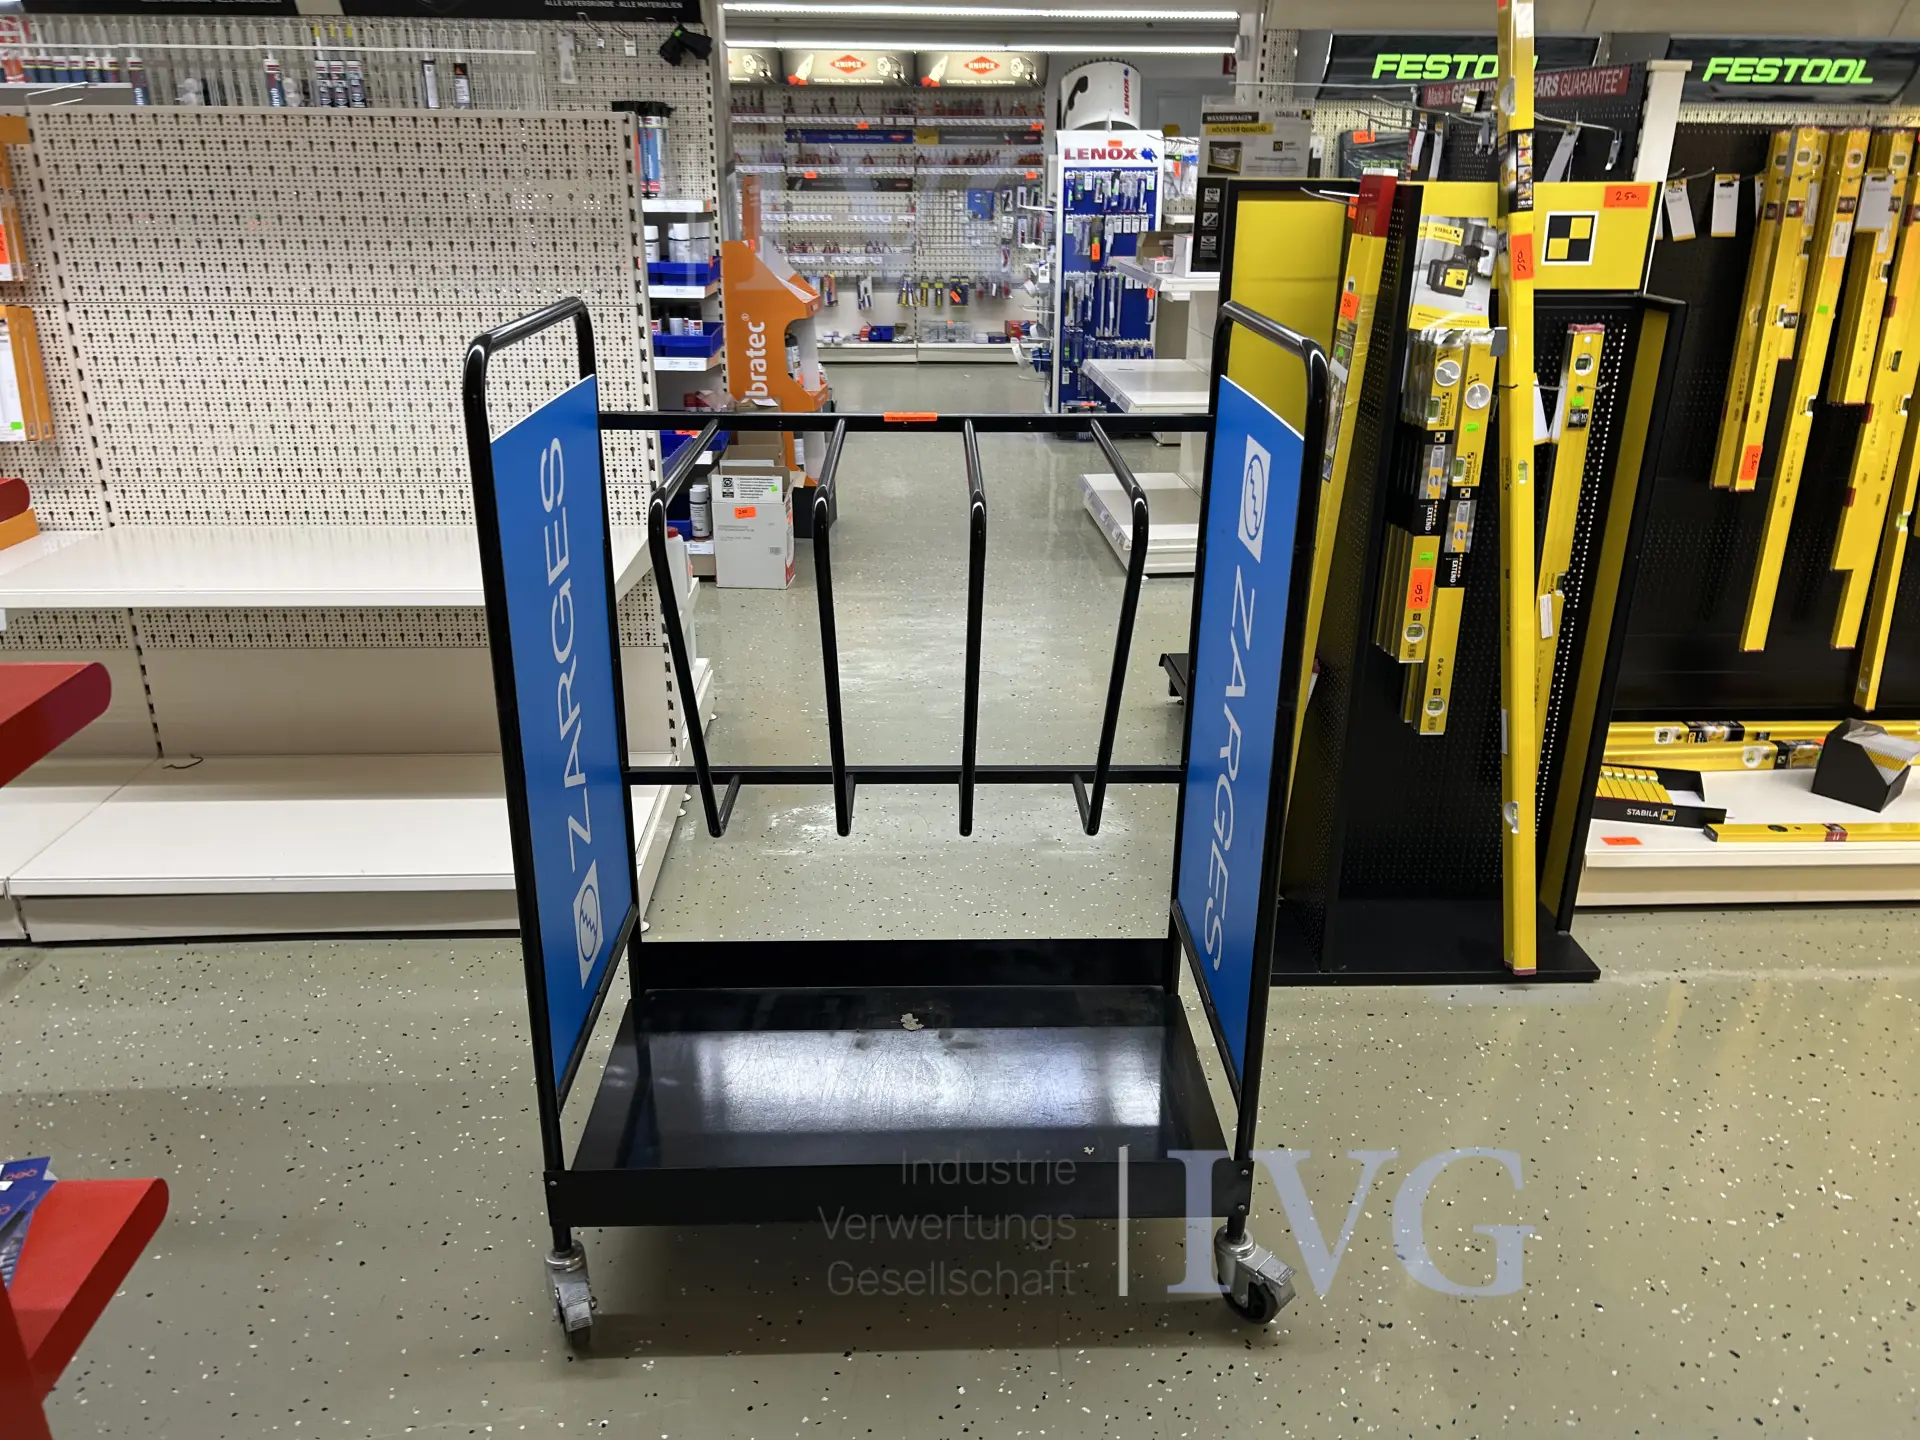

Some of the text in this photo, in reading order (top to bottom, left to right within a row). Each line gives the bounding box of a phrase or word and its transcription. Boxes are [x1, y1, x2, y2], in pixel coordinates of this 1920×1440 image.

[1371, 53, 1539, 80] FESTO
[1702, 56, 1874, 84] FESTOOL
[1123, 77, 1131, 116] LENOX
[1426, 87, 1444, 106] Made
[1534, 75, 1560, 98] EARS
[1274, 110, 1299, 118] STABILA
[1211, 124, 1241, 133] HÖCHSTER
[1064, 147, 1139, 160] LENOX
[1439, 401, 1448, 427] STABILA
[1464, 461, 1473, 485] STABILA
[1424, 506, 1434, 531] EXTEND
[1449, 559, 1459, 583] EXTEND
[541, 437, 592, 873] ZARGES
[1204, 564, 1256, 971] ZARGES
[1626, 808, 1659, 818] STABILA
